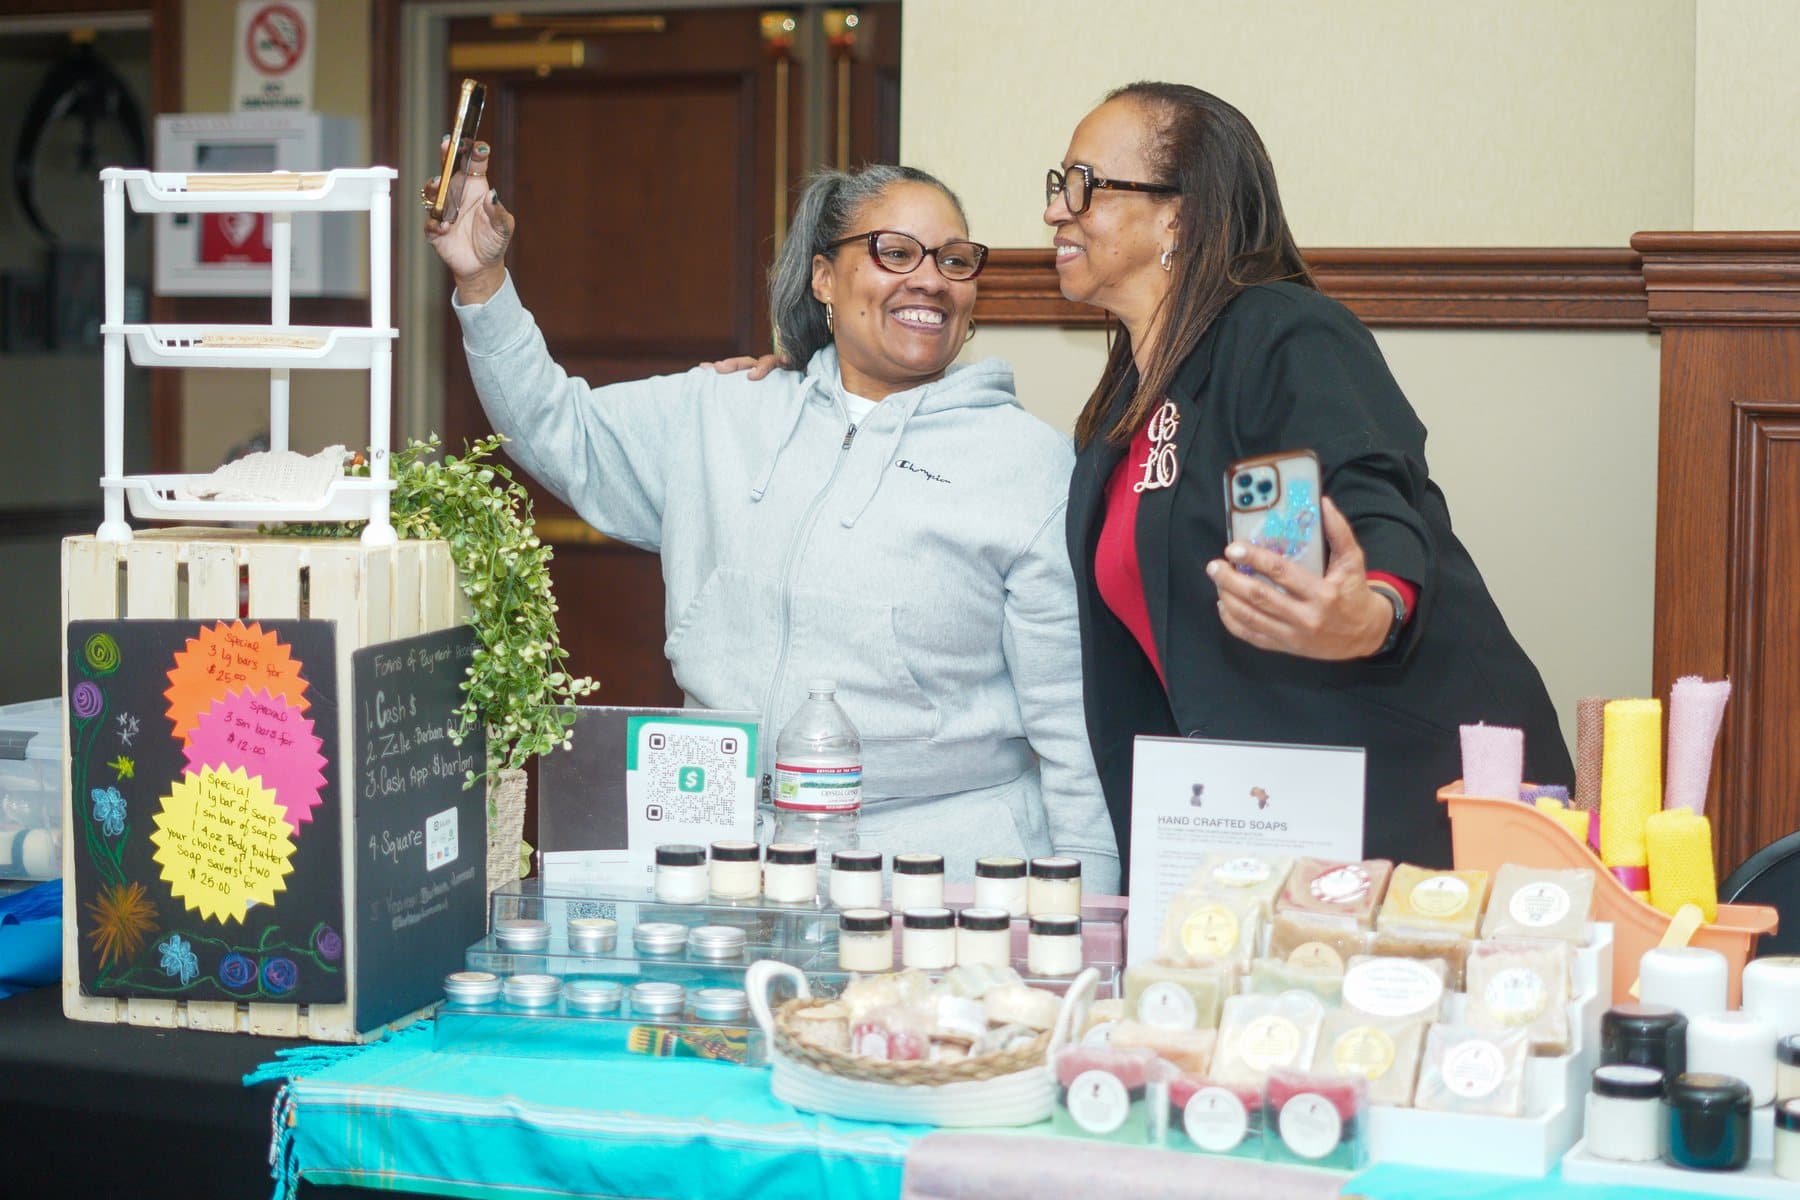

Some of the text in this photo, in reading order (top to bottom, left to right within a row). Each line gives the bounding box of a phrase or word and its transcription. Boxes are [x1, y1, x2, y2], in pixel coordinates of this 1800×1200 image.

[208, 644, 217, 657] 3
[237, 653, 258, 670] bars
[266, 663, 285, 678] for
[376, 690, 406, 729] Cash
[224, 711, 233, 722] 3
[277, 732, 296, 748] for
[207, 773, 250, 798] Special
[219, 793, 236, 808] bar
[238, 799, 249, 815] of
[219, 811, 236, 826] bar
[239, 818, 250, 837] of
[1157, 815, 1289, 832] HAND CRAFTED SOAPS
[191, 836, 226, 856] choice
[227, 834, 248, 854] Body
[380, 829, 423, 864] Square
